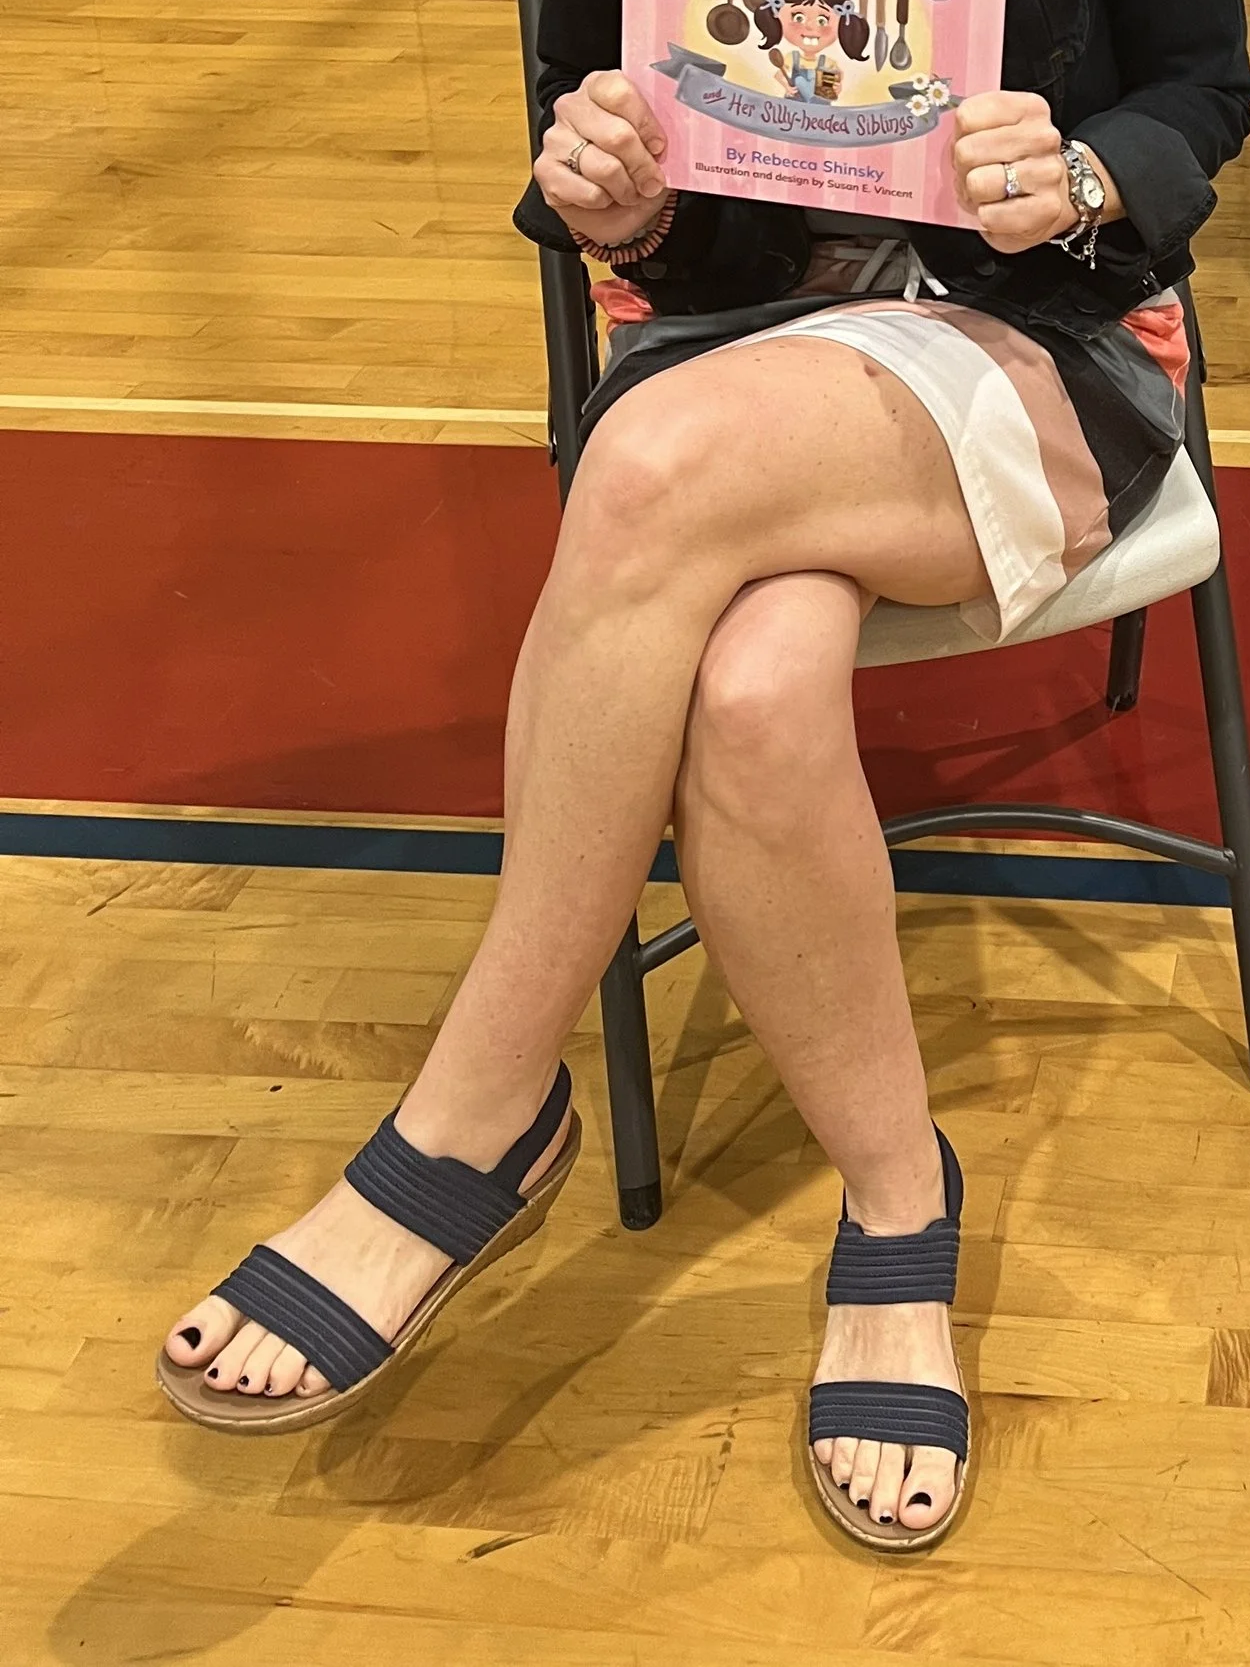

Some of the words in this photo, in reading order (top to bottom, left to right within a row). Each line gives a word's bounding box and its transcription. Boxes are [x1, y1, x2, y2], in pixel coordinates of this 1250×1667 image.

[703, 89, 725, 103] and
[728, 93, 755, 117] Her
[761, 101, 850, 134] Silly-headed
[856, 114, 914, 136] Siblings
[695, 162, 750, 178] Illustration
[753, 170, 773, 181] and
[775, 173, 810, 189] design
[812, 177, 825, 189] by
[827, 179, 859, 193] Susan
[874, 185, 913, 199] Vincent
[726, 147, 746, 163] By
[751, 150, 817, 171] Rebecca
[823, 160, 884, 183] Shinsky
